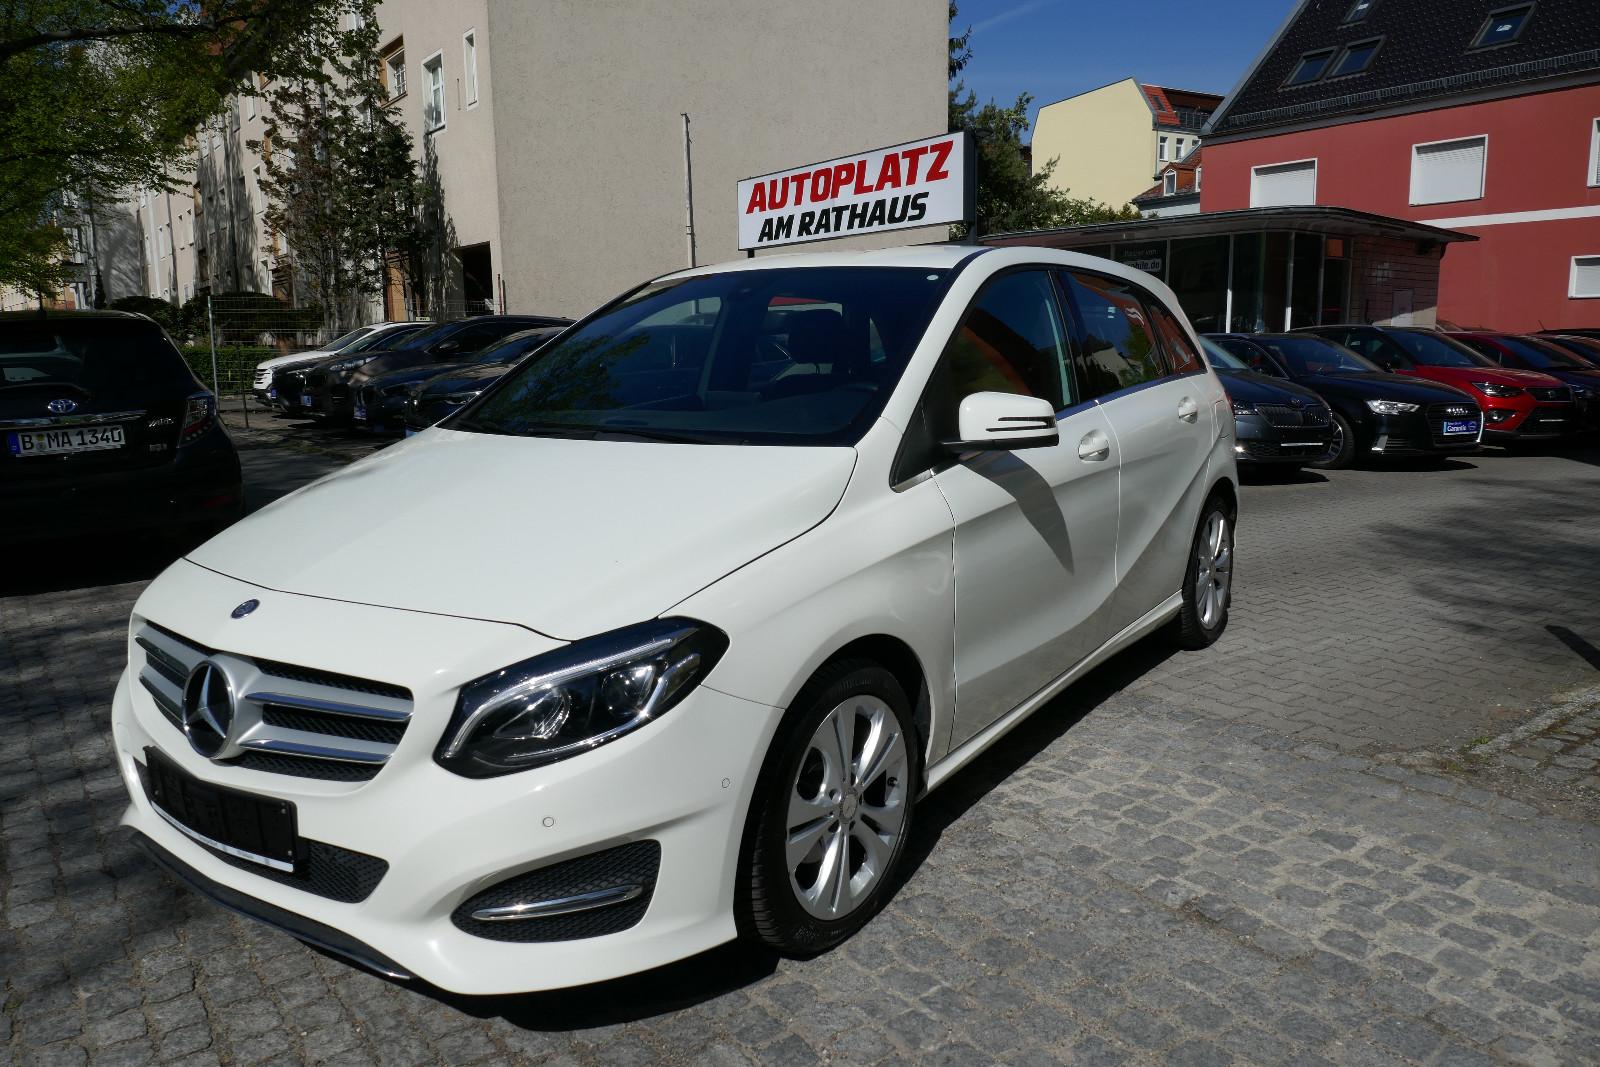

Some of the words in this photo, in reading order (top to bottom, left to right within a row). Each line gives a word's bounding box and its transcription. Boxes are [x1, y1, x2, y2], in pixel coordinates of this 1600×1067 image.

[745, 140, 954, 215] AUTOPLATZ
[757, 214, 795, 243] AM
[797, 191, 930, 237] RATHAUS
[20, 434, 34, 451] B
[46, 431, 72, 448] MA
[75, 427, 123, 446] 1340
